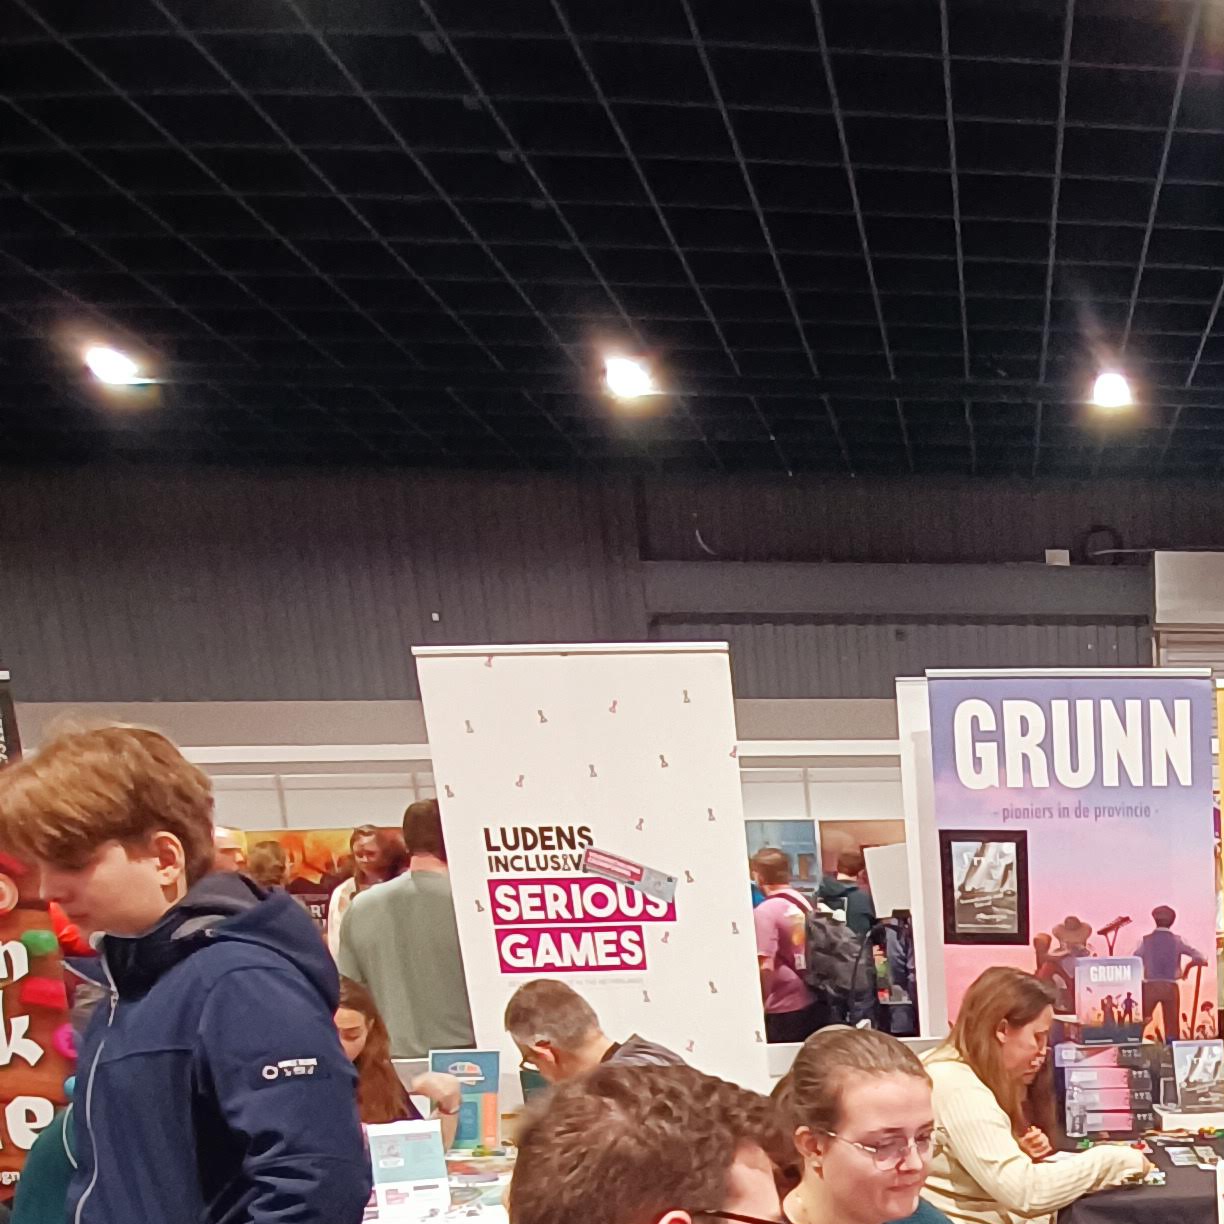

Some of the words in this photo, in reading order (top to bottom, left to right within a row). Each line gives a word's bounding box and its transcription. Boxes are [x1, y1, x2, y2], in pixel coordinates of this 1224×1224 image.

[953, 698, 1193, 789] GRUNN
[1002, 803, 1053, 823] pioniers
[1058, 802, 1070, 818] in
[1074, 800, 1089, 818] de
[1095, 801, 1151, 821] provincie
[484, 826, 594, 852] LUDENS
[488, 853, 590, 873] INCLUSIV
[494, 883, 669, 921] SERIOUS
[501, 930, 644, 968] GAMES
[1089, 965, 1132, 983] GRUNN
